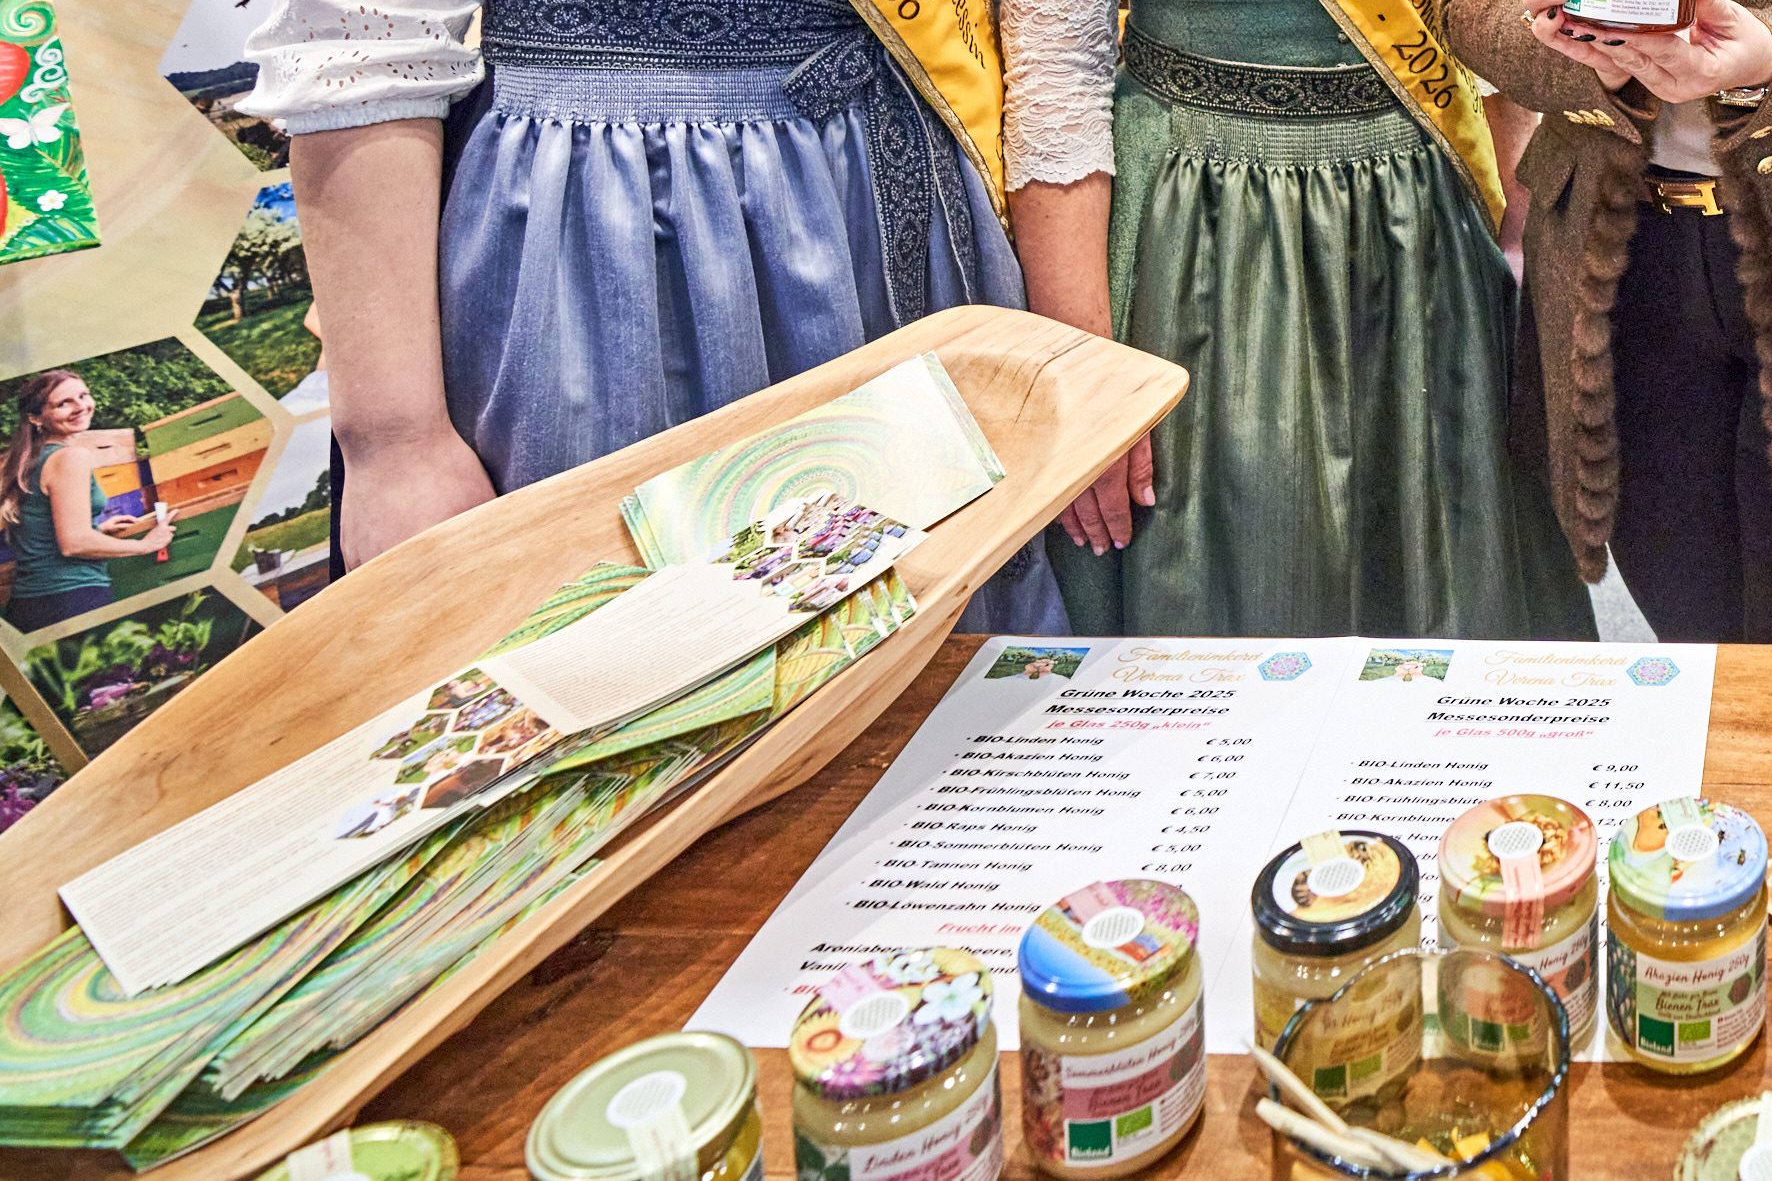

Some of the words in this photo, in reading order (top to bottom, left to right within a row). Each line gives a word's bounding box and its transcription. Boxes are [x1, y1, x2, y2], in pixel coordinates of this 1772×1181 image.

[1391, 30, 1459, 109] 2026
[1118, 647, 1263, 664] Familienimkerei
[1484, 650, 1629, 667] Familienimkerei
[1112, 665, 1184, 683] Verena
[1189, 666, 1246, 682] Trax
[1484, 669, 1554, 686] Verena
[1560, 670, 1617, 687] Trax
[1060, 688, 1117, 699] Grüne
[1121, 688, 1184, 699] Woche
[1188, 689, 1237, 699] 2025
[1437, 695, 1493, 707] Grüne
[1498, 697, 1560, 707] Woche
[1565, 698, 1612, 707] 2025
[1044, 704, 1231, 716] Messesonderpreise
[1427, 712, 1611, 724] Messesonderpreise
[1046, 720, 1065, 730] je
[1068, 720, 1104, 729] Glas
[1111, 720, 1150, 731] 250g
[973, 734, 1060, 745] BIO-Linden
[1061, 736, 1105, 747] Honig
[1218, 738, 1253, 747] 5,00
[1433, 728, 1450, 738] je
[1457, 728, 1492, 737] Glas
[1497, 729, 1536, 739] 500g
[962, 751, 1053, 762] BIO-Akazien
[1055, 752, 1104, 763] Honig
[1210, 754, 1245, 763] 6,00
[1358, 760, 1442, 770] BIO-Linden
[1444, 761, 1490, 772] Honig
[1606, 764, 1639, 774] 9,00
[950, 768, 1084, 779] BIO-Kirschblüten
[1086, 770, 1131, 781] Honig
[1202, 771, 1237, 780] 7,00
[1351, 777, 1447, 787] BIO-Akazien
[1448, 779, 1494, 790] Honig
[1603, 781, 1646, 791] 11,50
[938, 785, 1095, 798] BIO-Frühlingsblüten
[1096, 788, 1142, 799] Honig
[1192, 789, 1228, 798] 5,00
[1344, 795, 1488, 807] BIO-Frühlingsblüte
[1598, 799, 1633, 809] 8,00
[924, 803, 1055, 814] BIO-Kornblumen
[1057, 805, 1106, 817] Honig
[1184, 806, 1220, 815] 6,00
[1337, 813, 1456, 824] BIO-Kornblume
[911, 821, 986, 833] BIO-Raps
[988, 823, 1038, 834] Honig
[1174, 824, 1211, 834] 4,50
[897, 840, 1051, 852] BIO-Sommerblüten
[1054, 842, 1104, 854] Honig
[1165, 844, 1202, 854] 5,00
[884, 858, 982, 870] BIO-Tannen
[984, 861, 1033, 873] Honig
[1155, 863, 1193, 873] 8,00
[869, 878, 948, 890] BIO-Wald
[950, 880, 1000, 892] Honig
[853, 899, 990, 911] BIO-Löwenzahn
[991, 902, 1041, 914] Honig
[937, 922, 992, 933] Frucht
[996, 924, 1022, 933] im
[1539, 952, 1569, 972] Honig
[1644, 966, 1689, 987] Akazien
[1692, 967, 1725, 985] Honig
[1655, 996, 1693, 1011] Bienen
